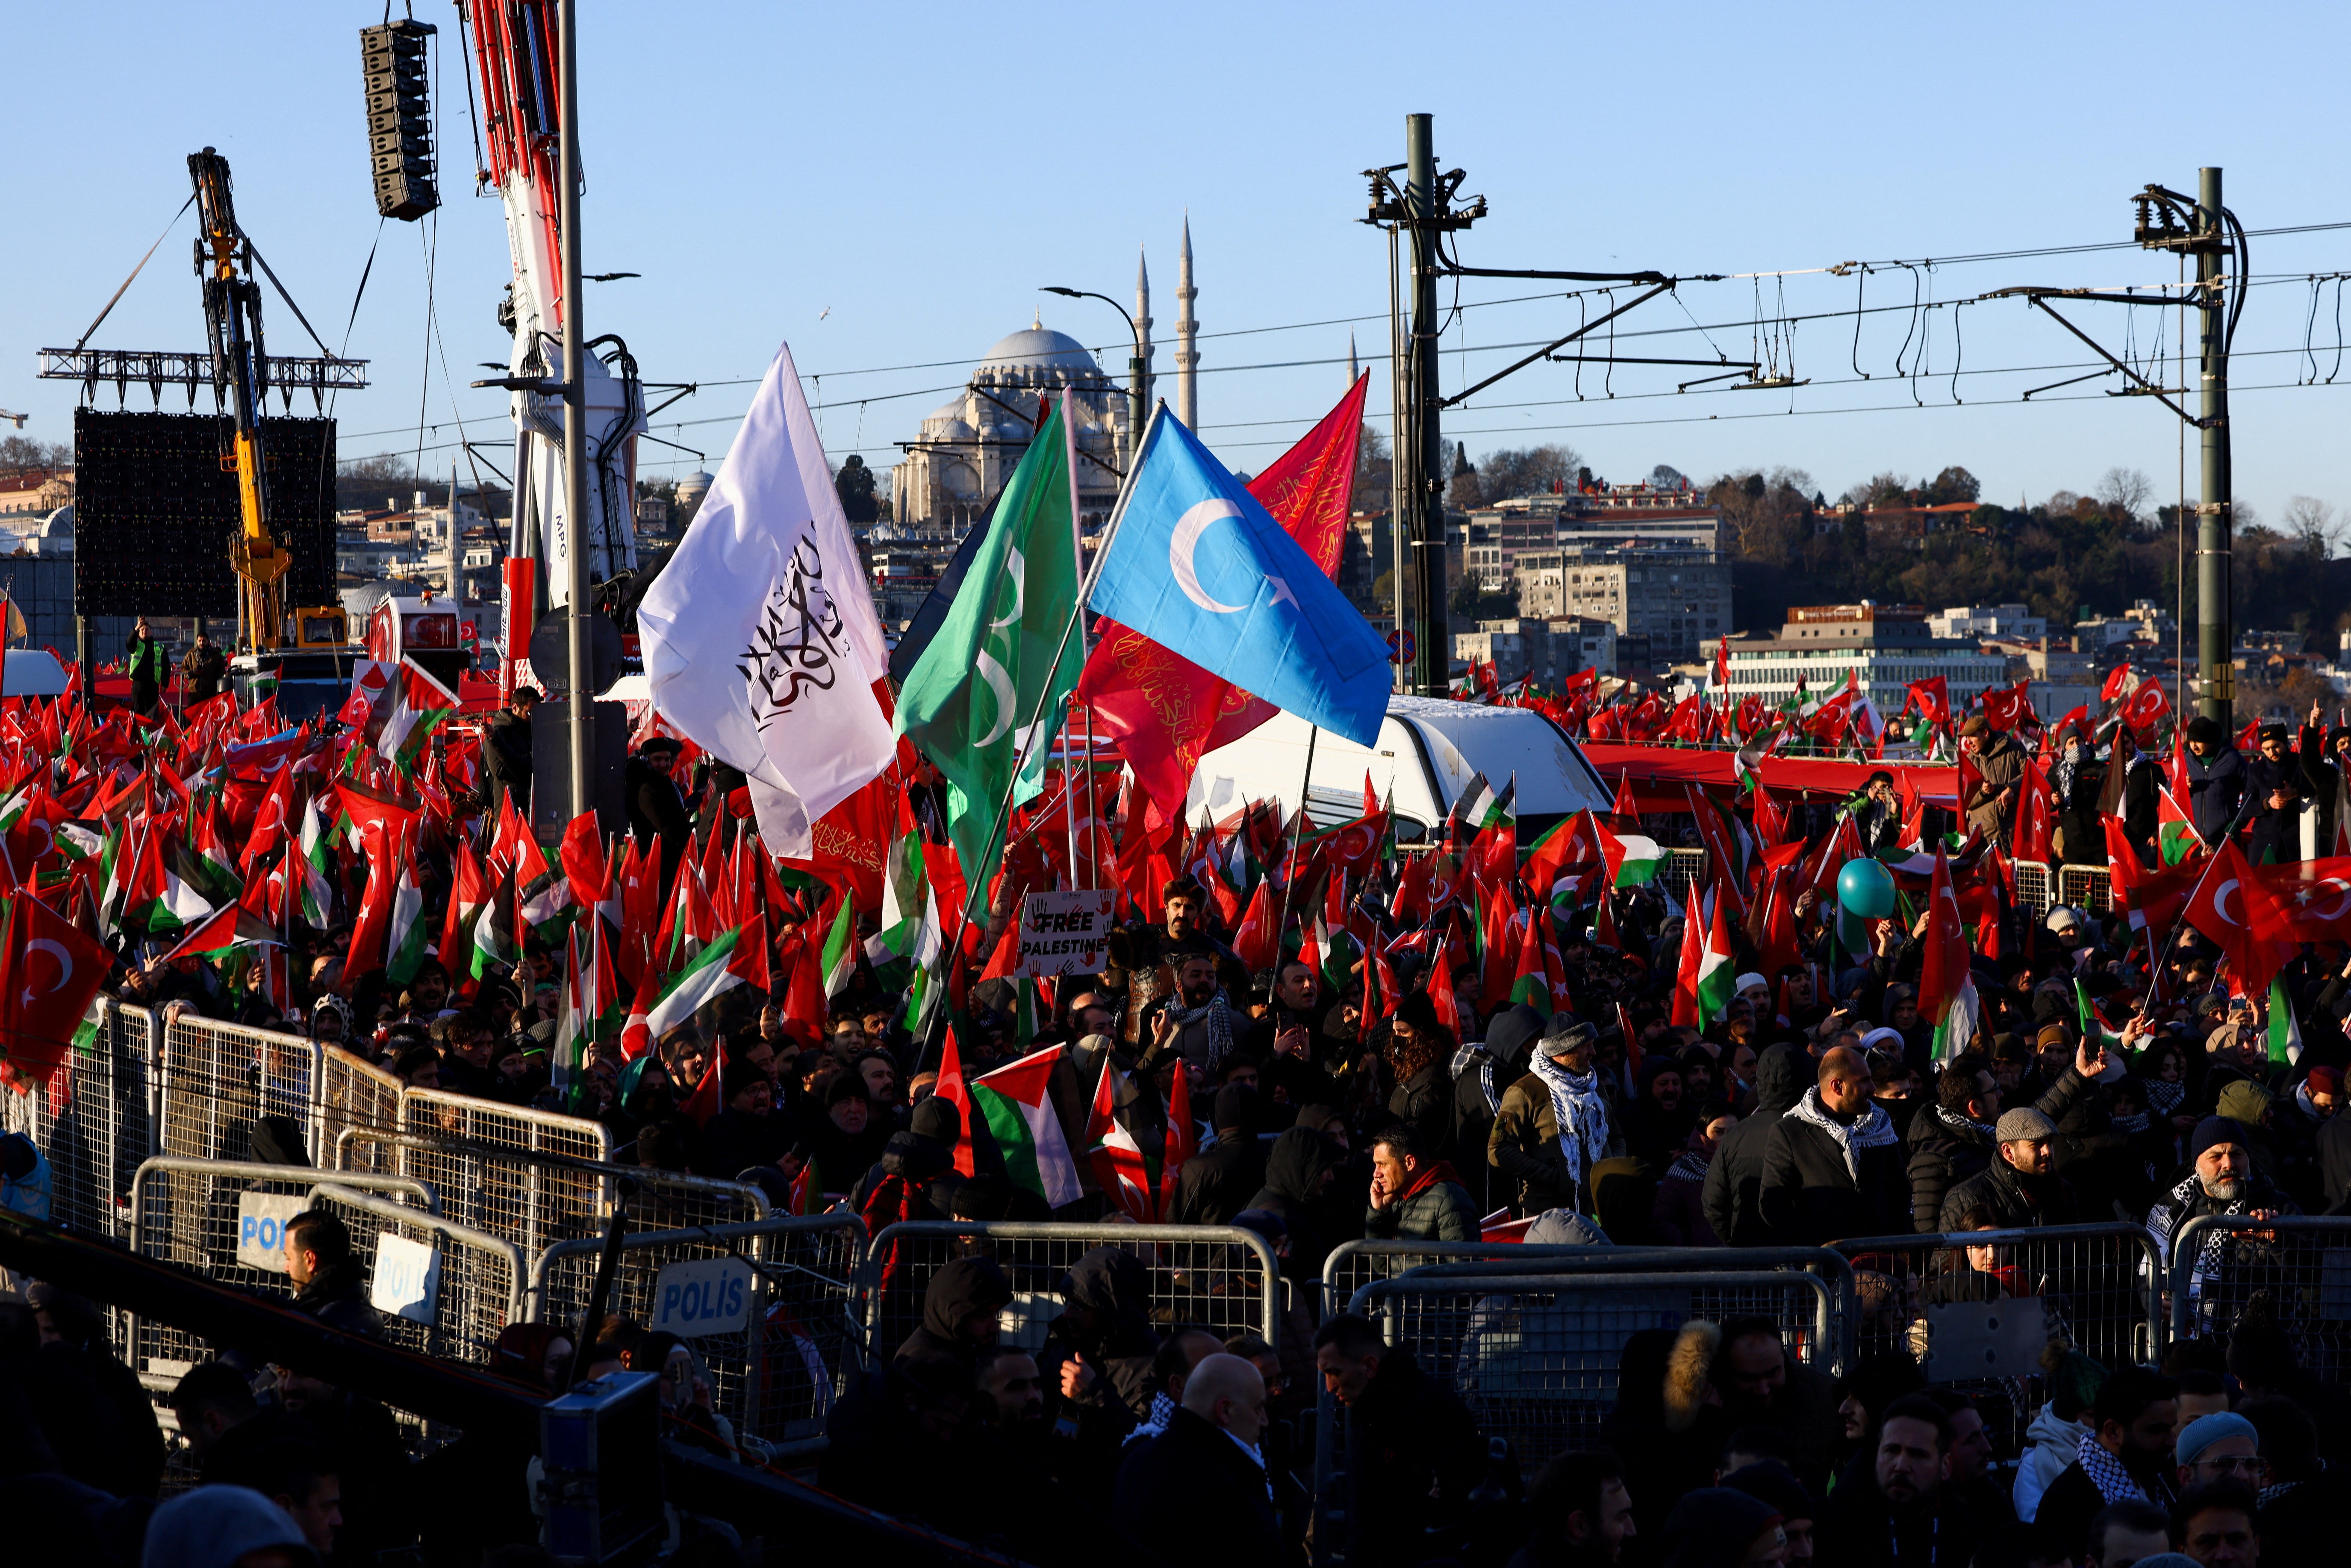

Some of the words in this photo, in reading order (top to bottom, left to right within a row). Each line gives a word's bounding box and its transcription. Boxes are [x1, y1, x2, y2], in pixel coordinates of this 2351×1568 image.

[556, 515, 567, 557] MPG
[1040, 912, 1094, 933] FREE
[1022, 938, 1105, 956] PALESTINE
[380, 1255, 432, 1309] POLİS
[662, 1270, 744, 1323] POLİS
